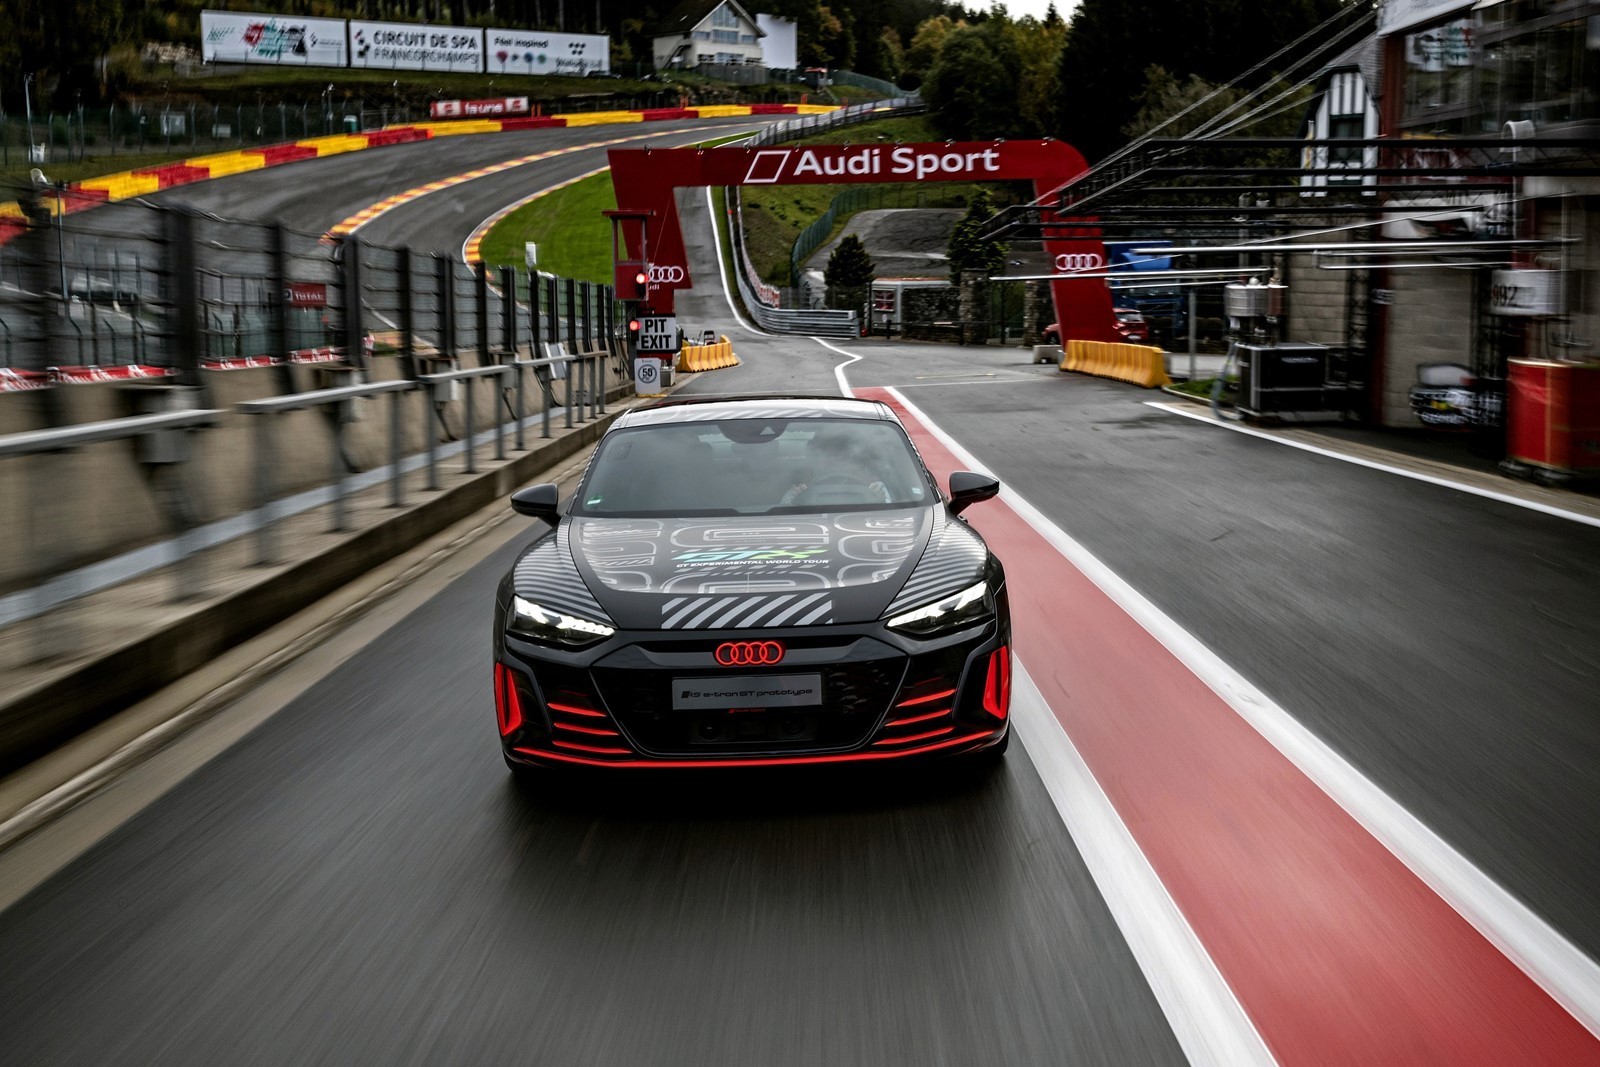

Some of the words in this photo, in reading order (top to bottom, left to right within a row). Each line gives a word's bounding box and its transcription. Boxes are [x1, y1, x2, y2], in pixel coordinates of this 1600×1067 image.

[373, 30, 427, 46] CIRCUIT
[430, 33, 449, 48] DE
[451, 34, 477, 50] SPA
[374, 46, 480, 64] FRANCORCHAMPS
[793, 148, 881, 176] Audi
[891, 147, 1001, 180] Sport
[644, 318, 667, 333] PIT
[640, 334, 671, 349] EXIT
[642, 368, 653, 377] 50
[703, 690, 739, 698] e-tron
[756, 688, 813, 698] prototype
